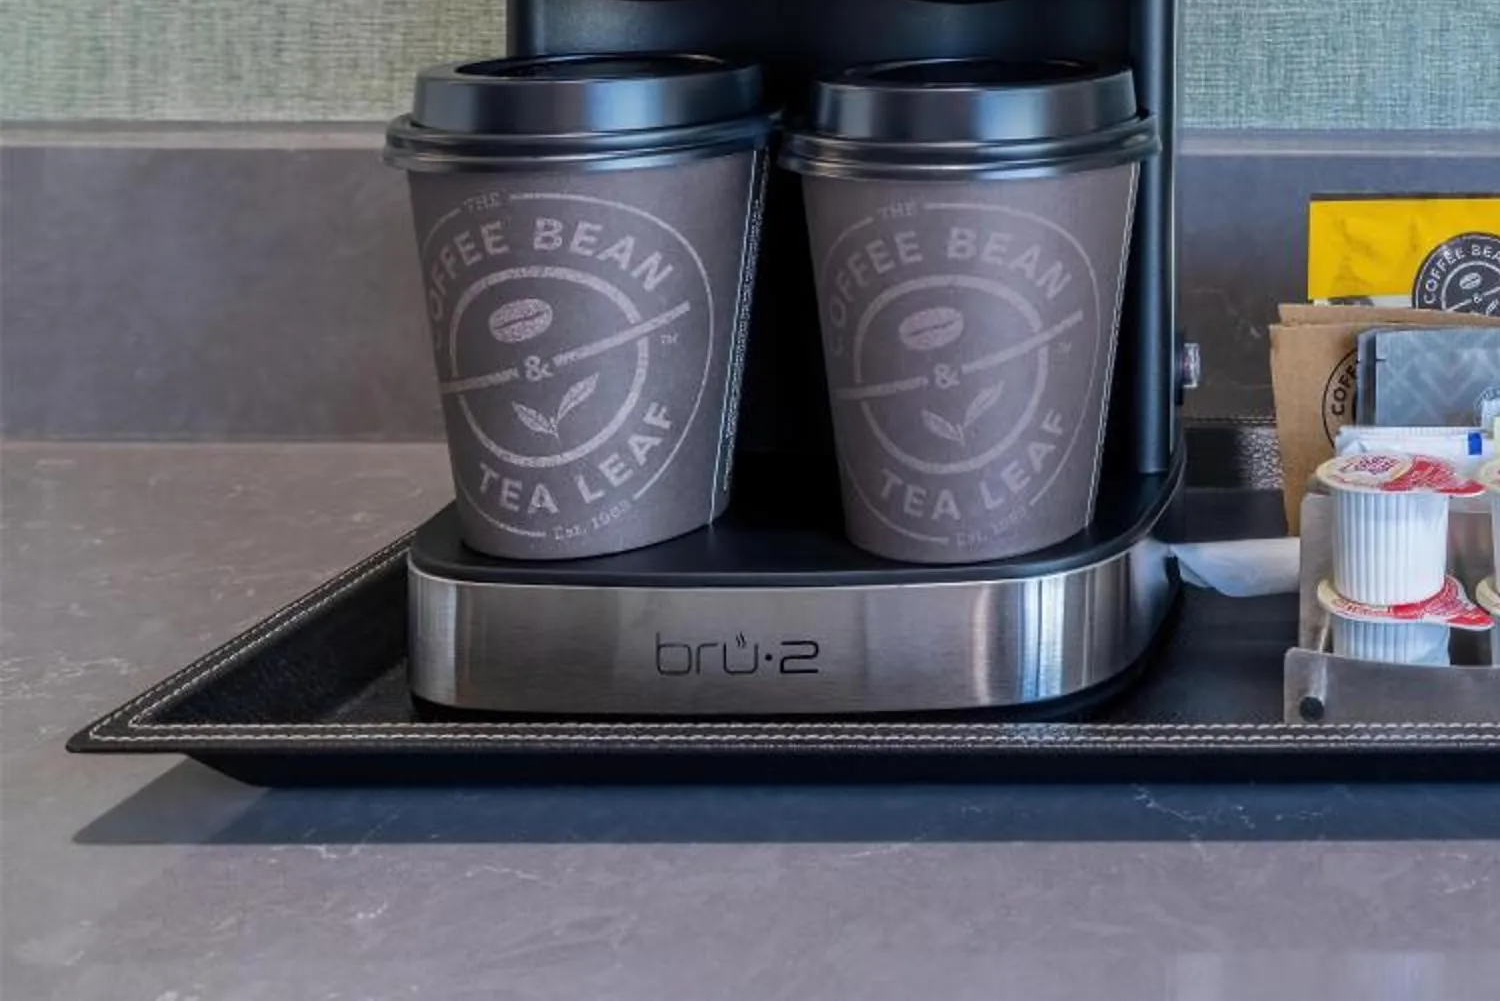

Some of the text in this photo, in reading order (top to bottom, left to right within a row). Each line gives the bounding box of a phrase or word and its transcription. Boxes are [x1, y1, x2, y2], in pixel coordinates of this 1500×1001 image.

[534, 218, 673, 292] BEAN
[946, 227, 1072, 299] BEAN
[1423, 246, 1466, 304] COFFEE
[525, 356, 553, 381] &
[935, 363, 960, 389] &
[479, 402, 673, 514] TEA LEAF
[881, 468, 960, 520] TEA
[979, 409, 1065, 510] LEAF
